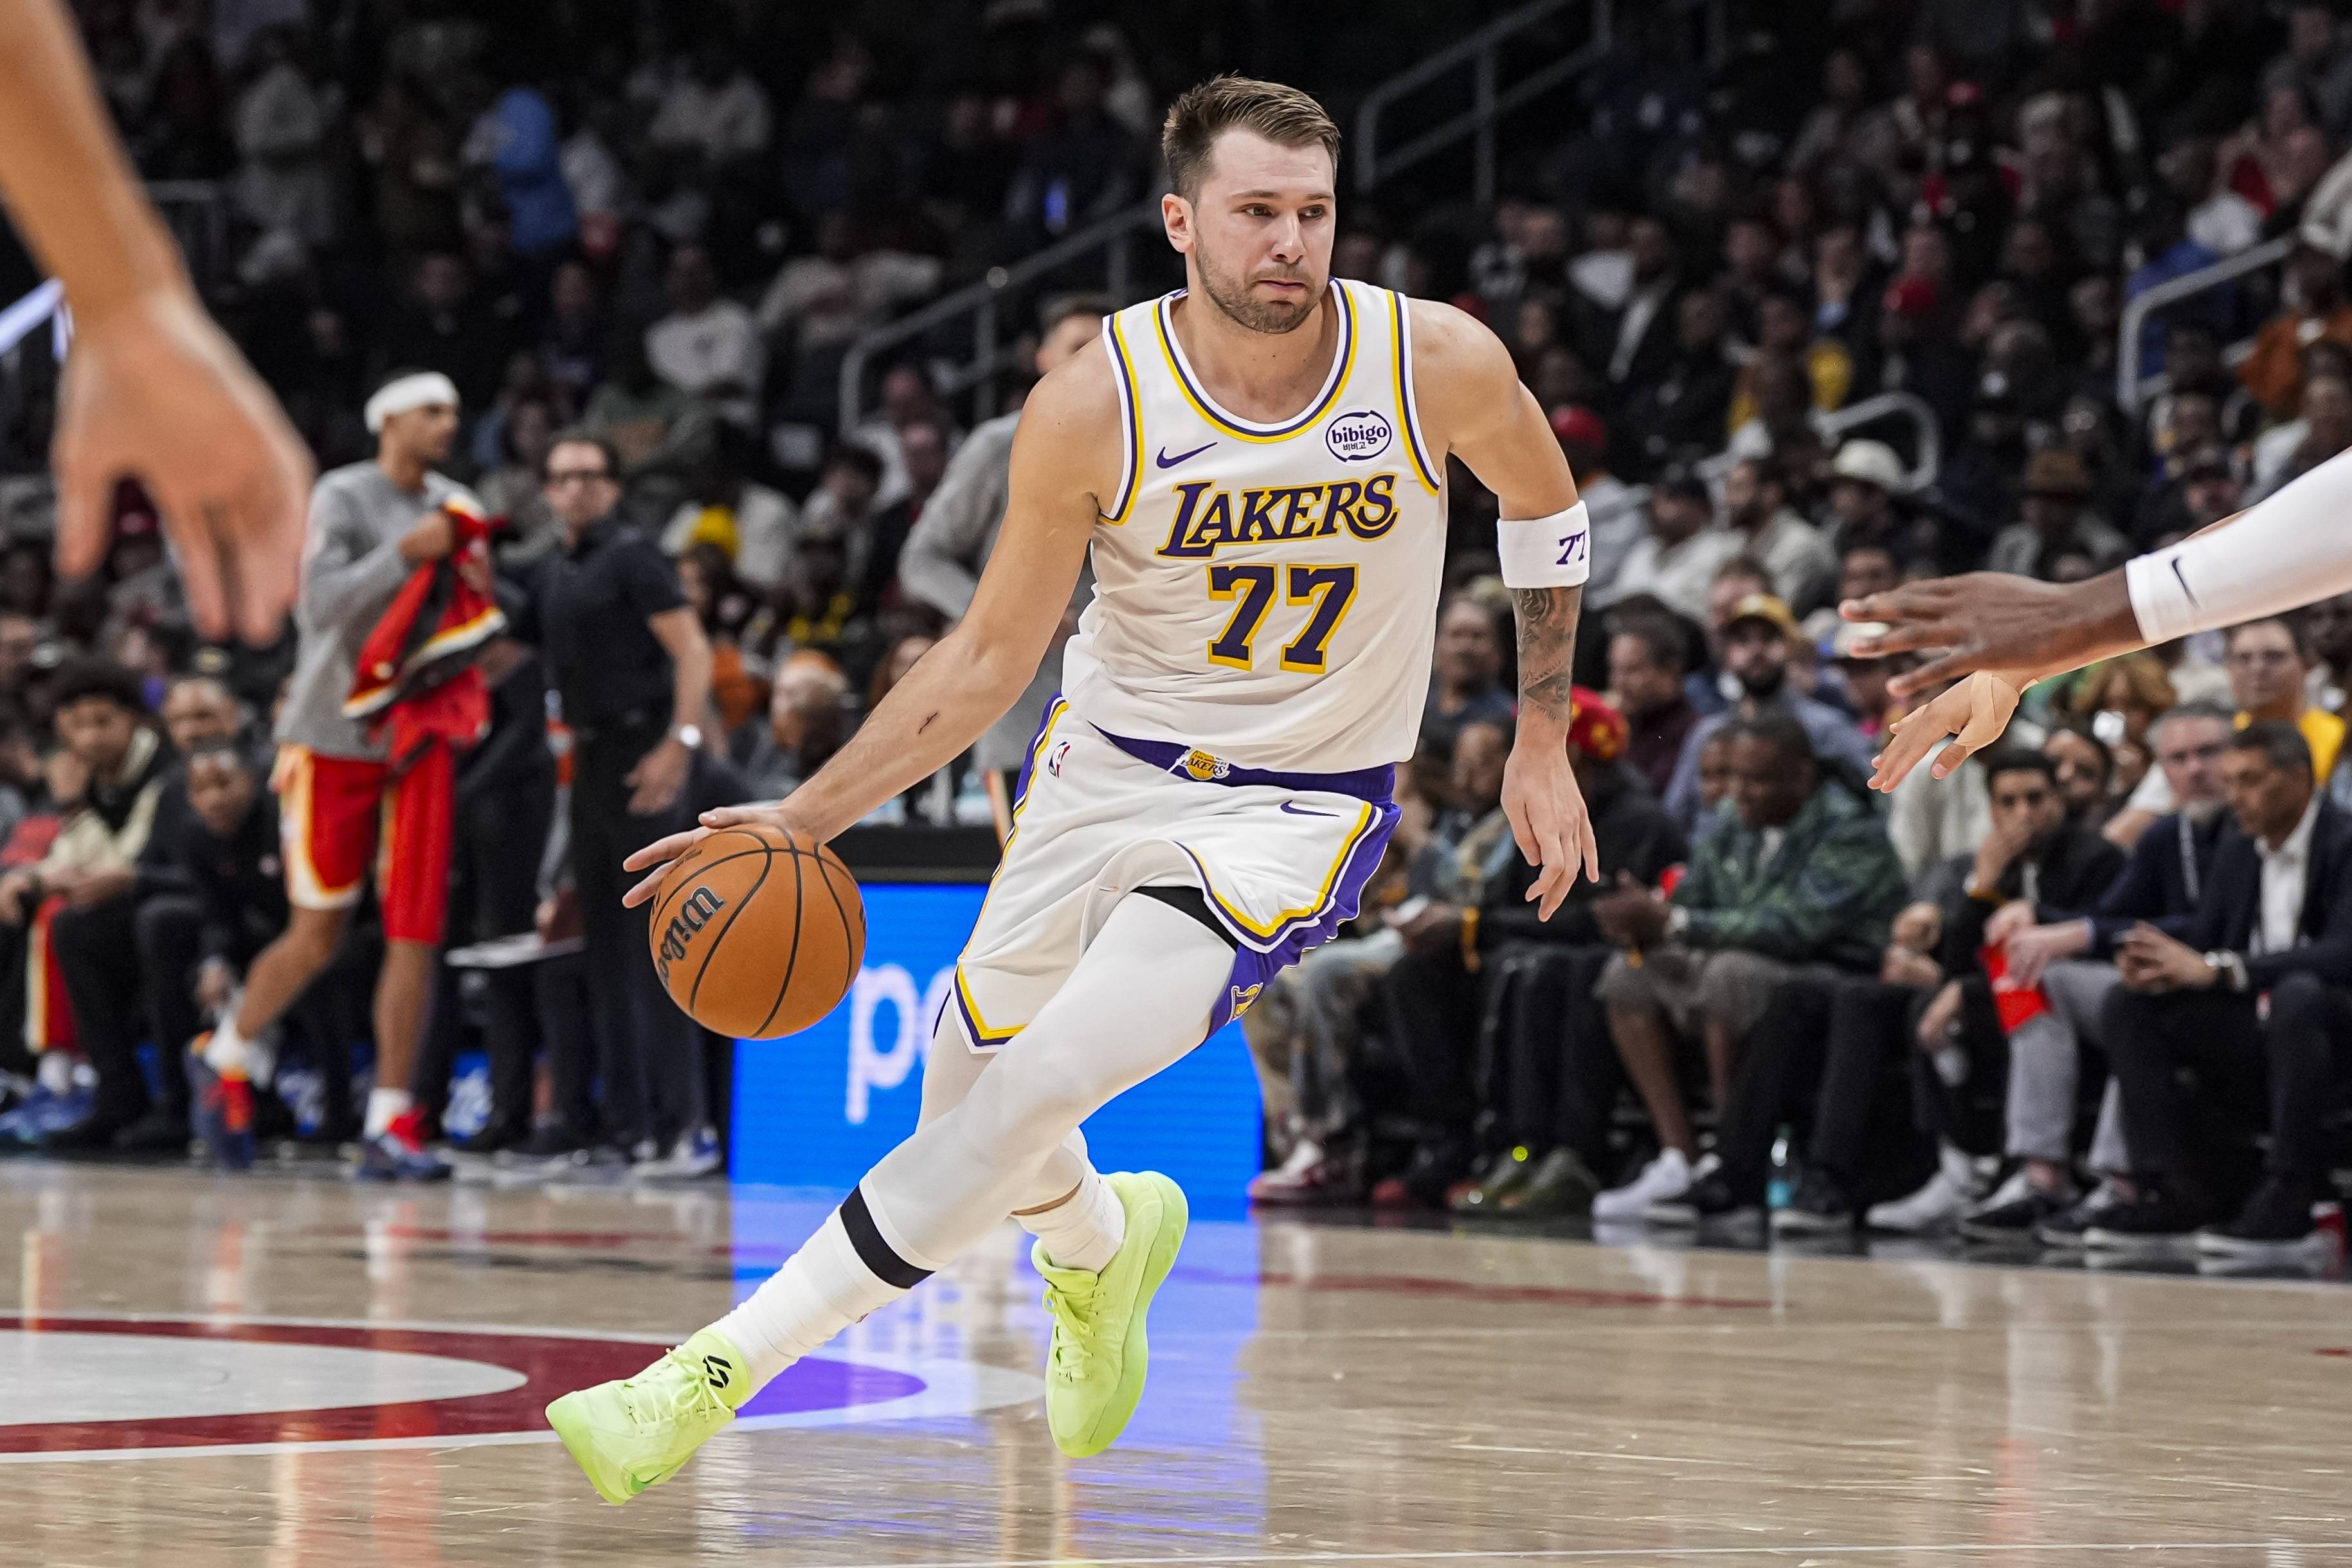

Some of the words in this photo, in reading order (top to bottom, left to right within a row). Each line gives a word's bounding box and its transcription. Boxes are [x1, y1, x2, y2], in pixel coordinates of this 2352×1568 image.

[1332, 424, 1388, 444] bibigo
[1343, 442, 1366, 451] 비비고
[1155, 473, 1401, 560] LAKERS
[1556, 530, 1586, 564] 77
[1206, 563, 1359, 674] 77
[657, 885, 725, 987] Wilso
